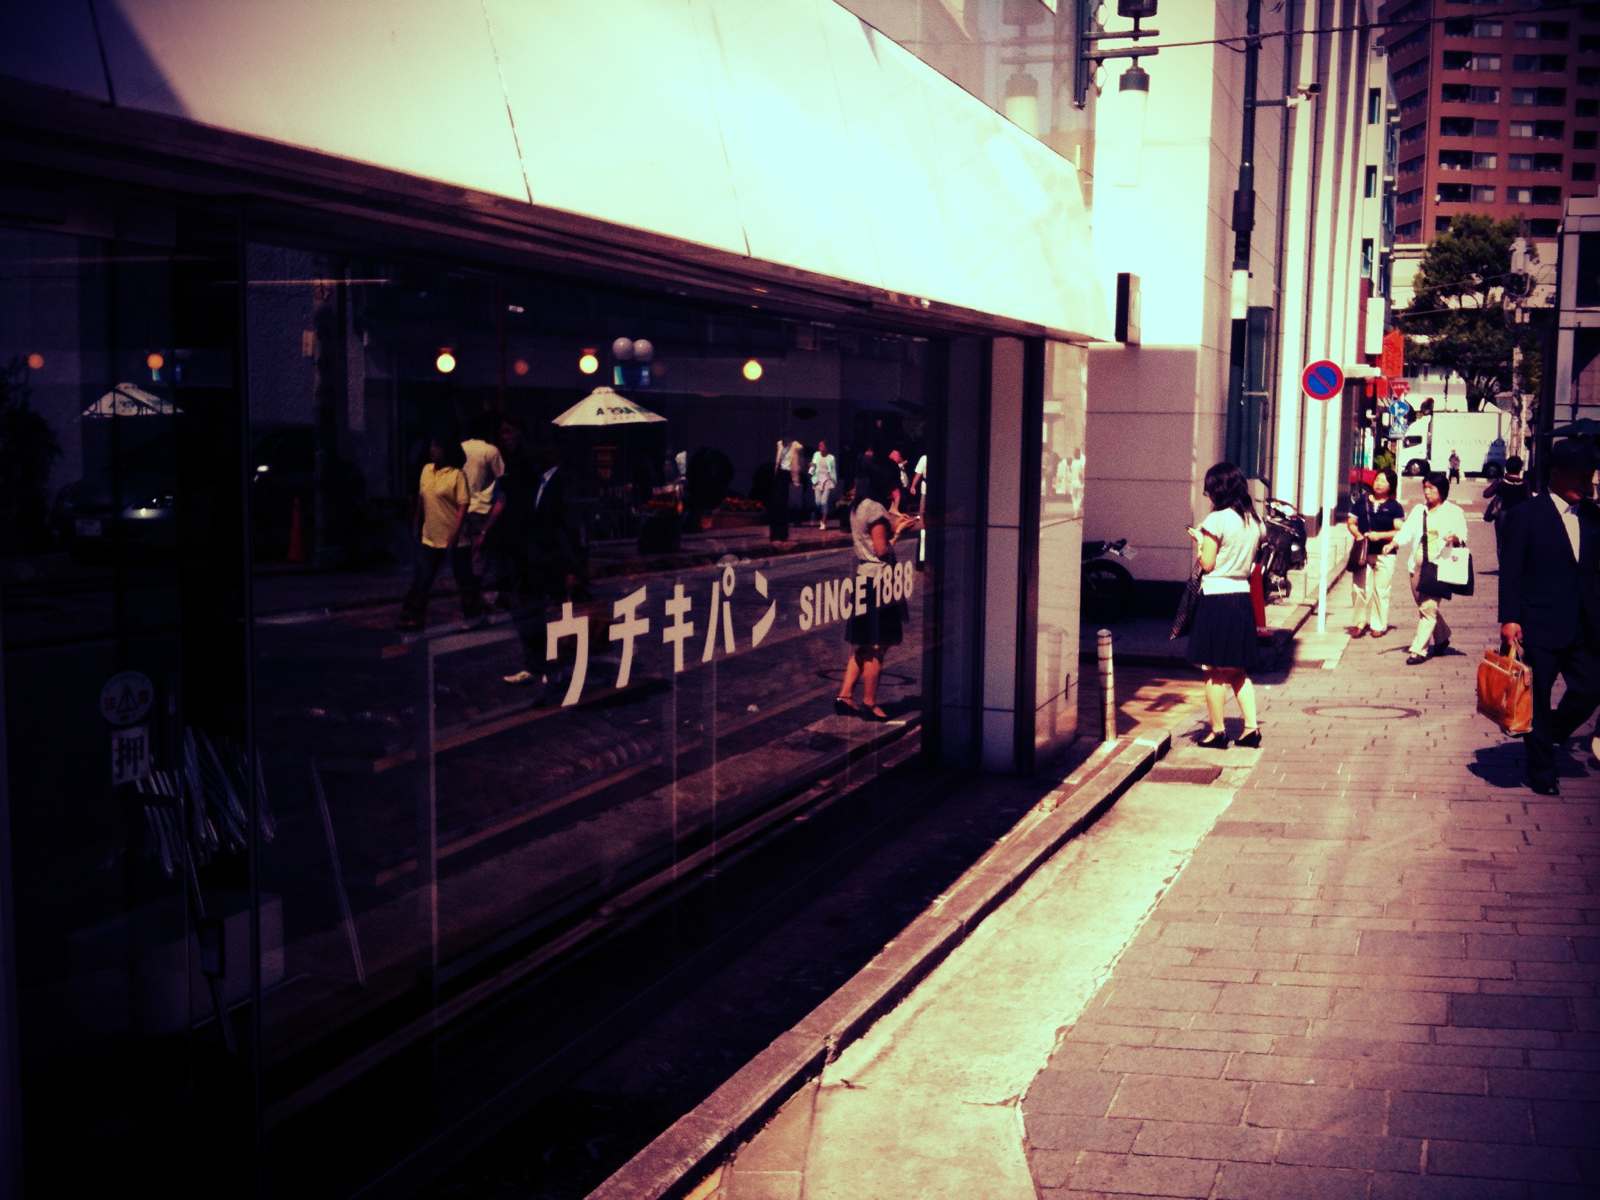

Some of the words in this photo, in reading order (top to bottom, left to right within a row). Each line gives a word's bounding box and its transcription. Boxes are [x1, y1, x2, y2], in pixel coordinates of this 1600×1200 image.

[546, 565, 776, 707] ウチキパン
[799, 577, 867, 631] SINCE
[873, 561, 913, 608] 1888
[115, 735, 144, 777] 押
